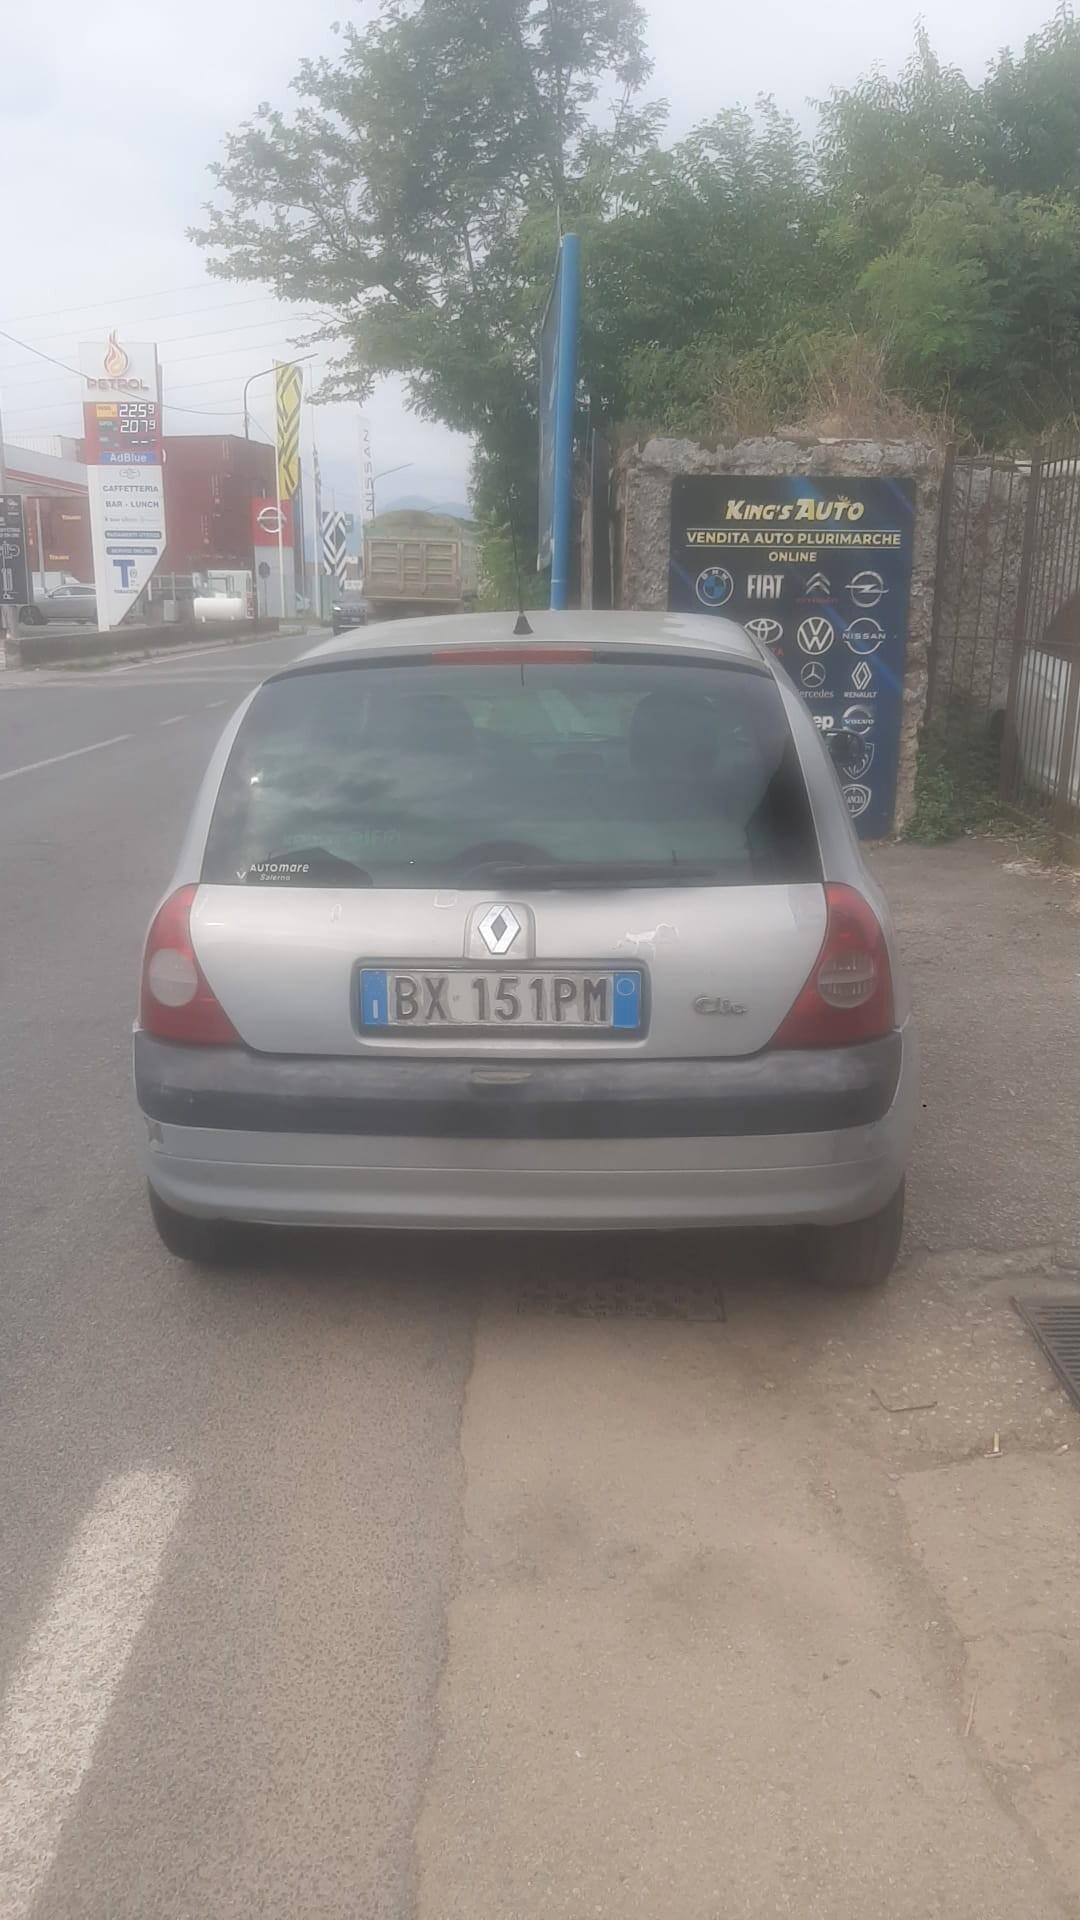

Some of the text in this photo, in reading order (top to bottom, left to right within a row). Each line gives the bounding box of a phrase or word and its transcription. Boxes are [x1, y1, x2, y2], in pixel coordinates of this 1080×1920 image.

[110, 452, 148, 463] AdBlue
[362, 428, 376, 516] NISSAN
[102, 484, 159, 493] CAFFETTERIA
[105, 500, 123, 508] BAR
[130, 500, 160, 509] LUNCH
[686, 531, 901, 546] VENDITA AUTO PLURIMARCHE
[768, 551, 817, 563] ONLINE
[747, 574, 785, 599] FIAT
[842, 632, 886, 640] NISSAN
[800, 689, 835, 699] ercedes
[843, 691, 878, 699] RENAULT
[843, 718, 875, 726] VOLVO
[260, 874, 291, 882] Salerno
[394, 975, 448, 1021] BX
[694, 994, 748, 1016] Clio
